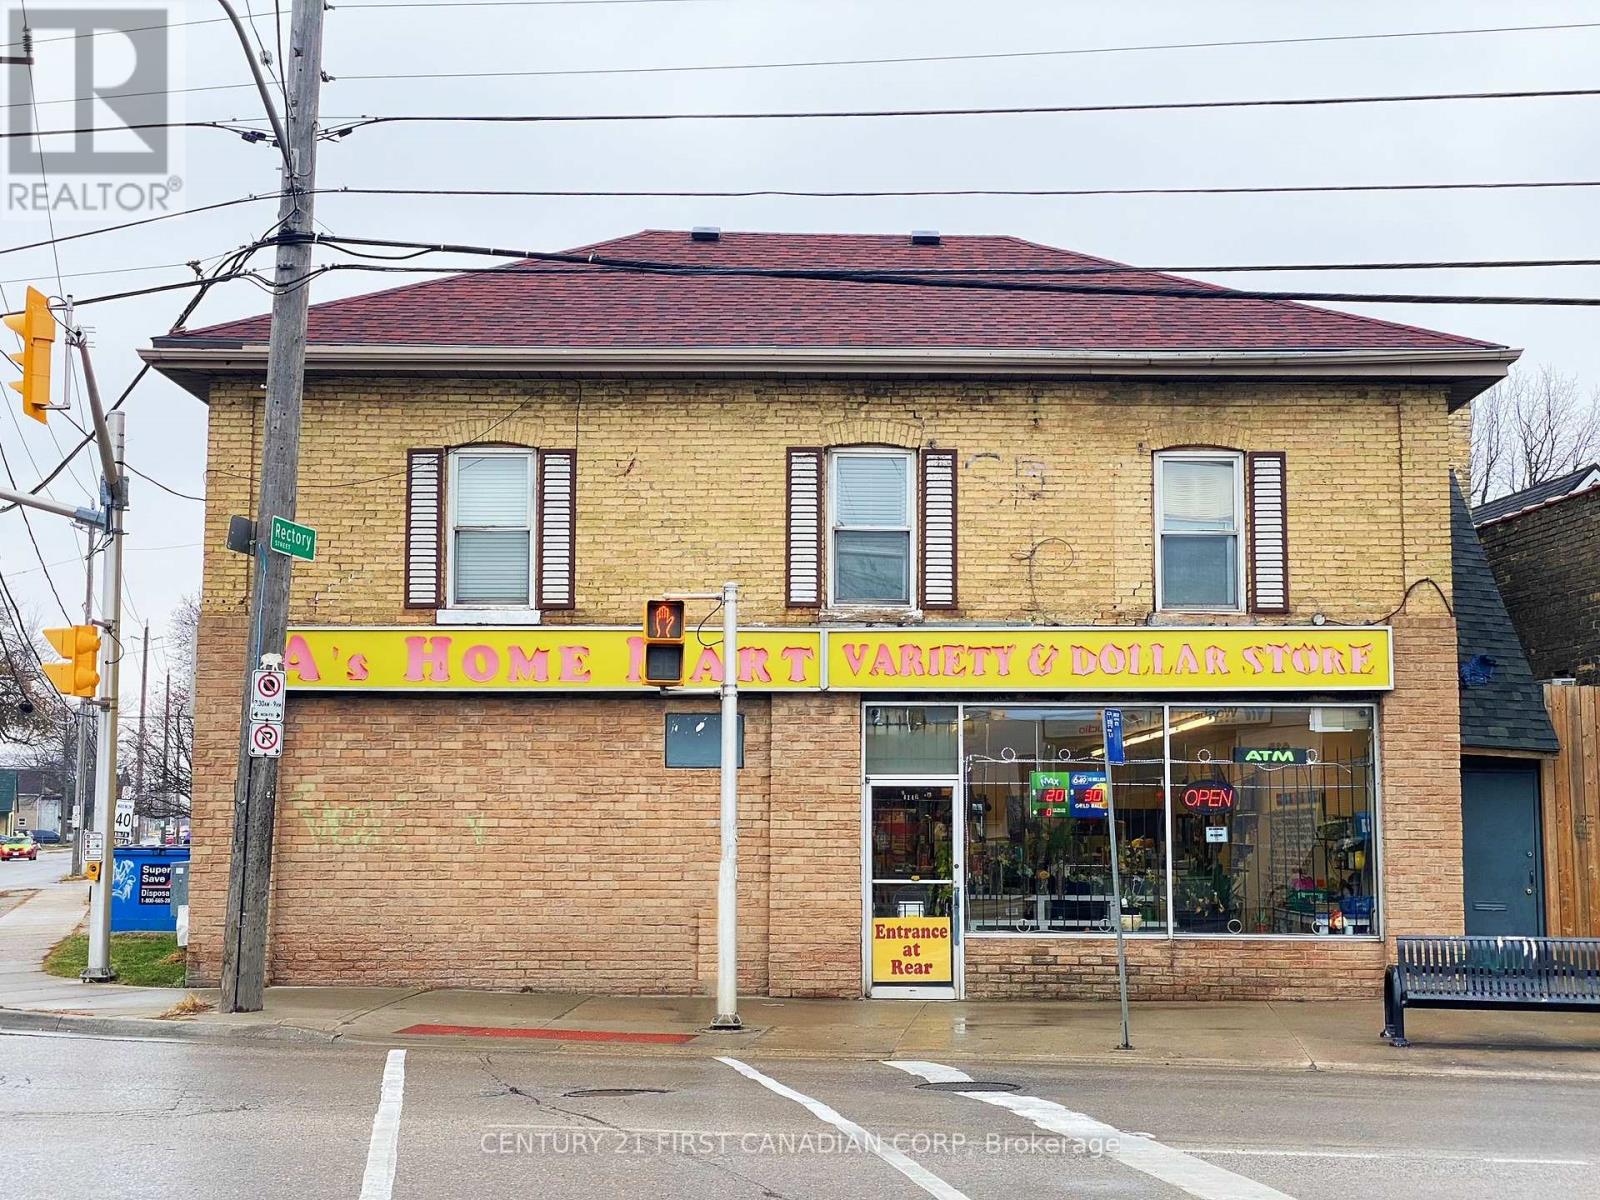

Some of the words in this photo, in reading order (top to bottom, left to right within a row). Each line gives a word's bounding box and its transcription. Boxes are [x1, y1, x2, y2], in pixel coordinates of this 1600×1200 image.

[275, 523, 311, 551] Rectory
[275, 540, 291, 550] STREET
[403, 636, 592, 682] HOME
[842, 643, 1016, 677] VARIETY
[1028, 643, 1059, 676] &
[1070, 643, 1231, 676] DOLLAR
[1242, 643, 1374, 675] STORE
[1245, 750, 1295, 762] ATM
[1184, 789, 1233, 807] OPEN
[115, 813, 131, 827] 40
[142, 865, 171, 875] Super
[142, 874, 166, 883] Save
[141, 889, 170, 898] Disposa
[875, 924, 948, 939] Entrance
[903, 943, 920, 957] at
[891, 960, 933, 975] Rear
